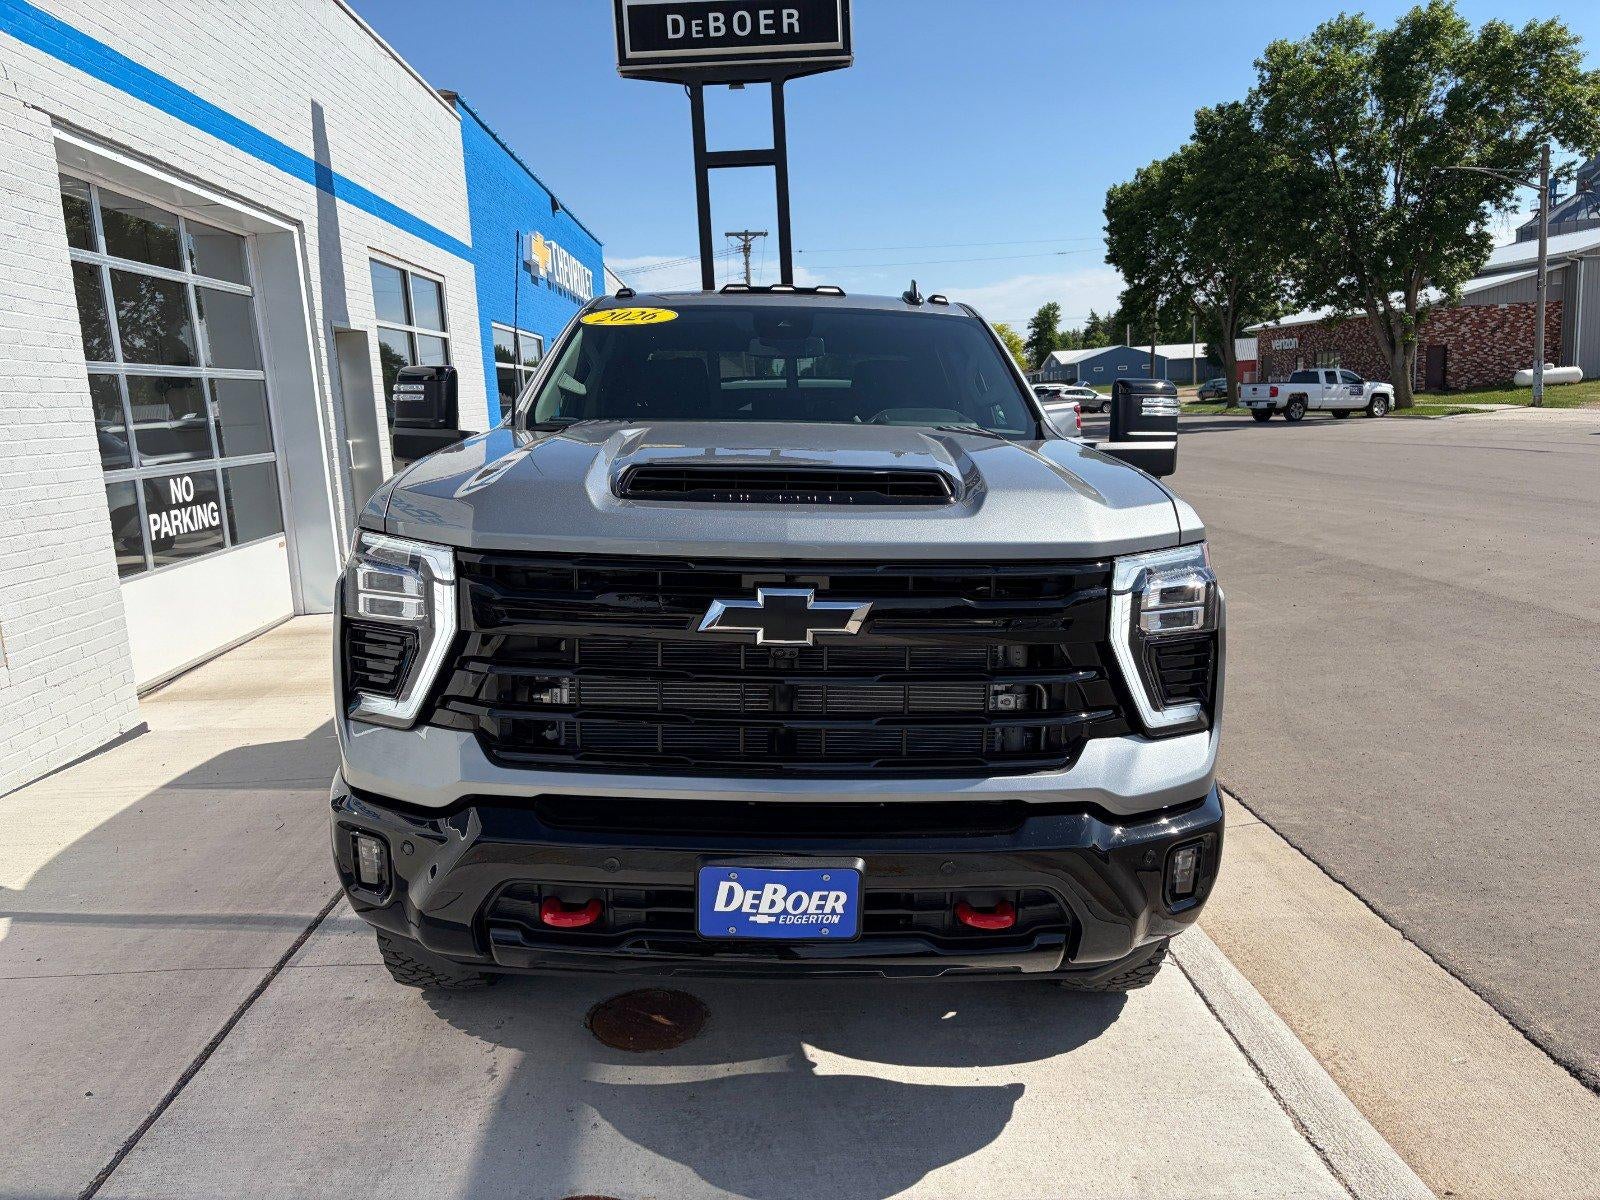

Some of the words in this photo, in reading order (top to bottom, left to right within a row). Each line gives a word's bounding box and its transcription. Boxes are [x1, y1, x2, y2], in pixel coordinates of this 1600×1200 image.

[548, 240, 593, 301] CHEVROLET
[593, 311, 660, 323] 2026
[169, 476, 194, 504] NO
[148, 501, 220, 541] PARKING
[778, 914, 841, 924] EDGERTON
